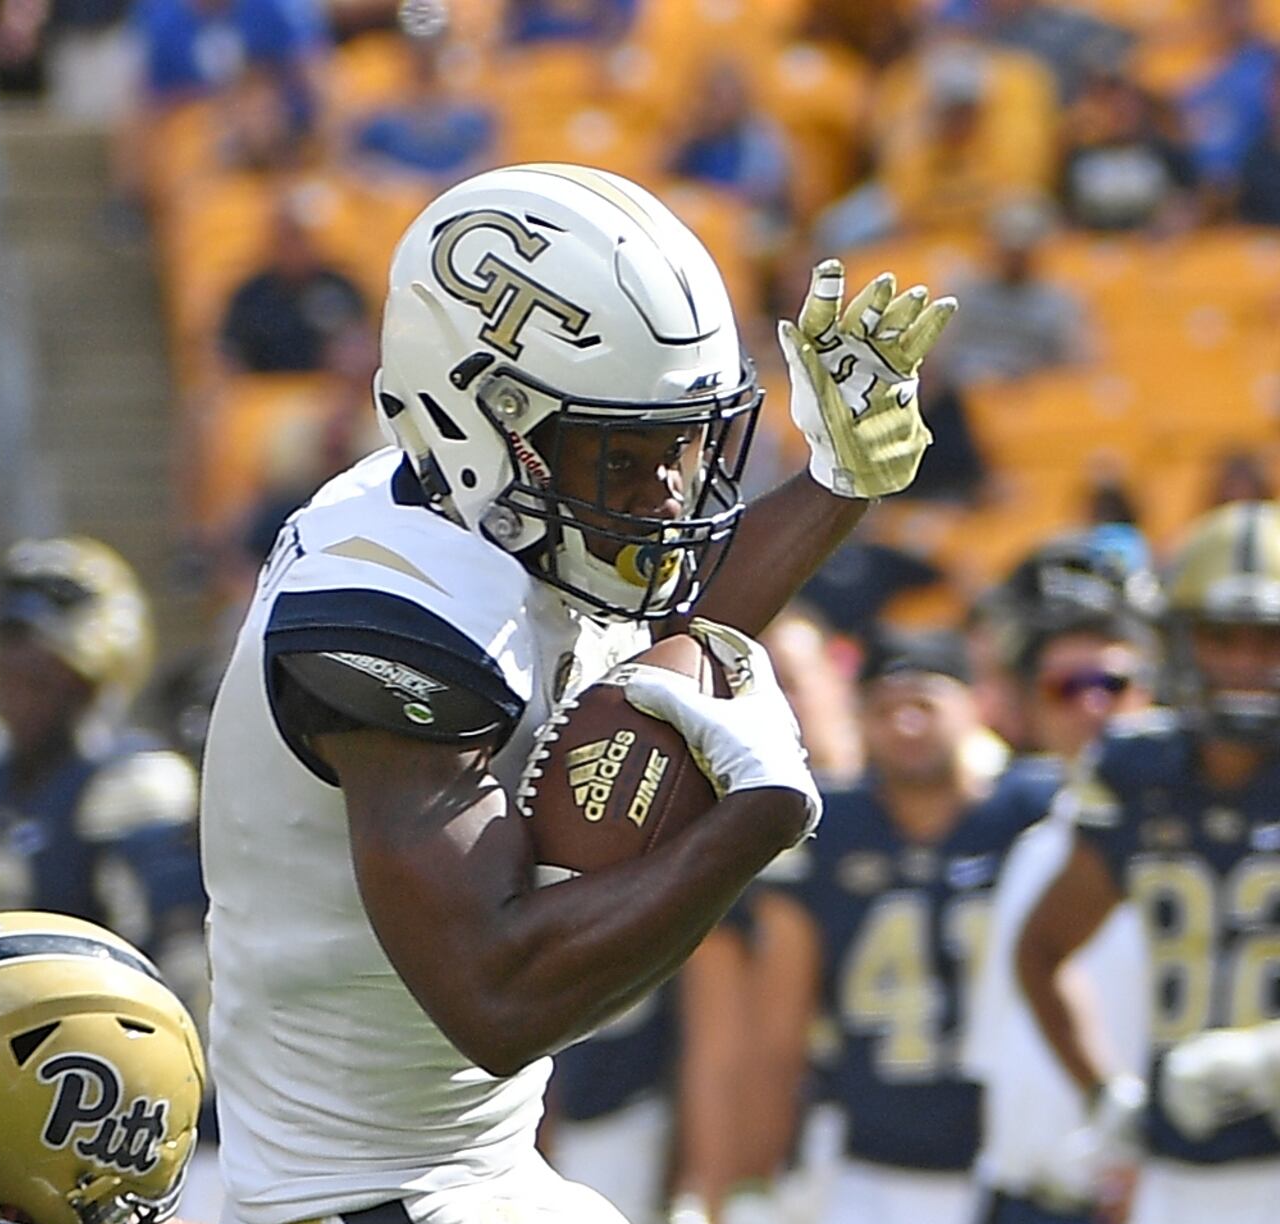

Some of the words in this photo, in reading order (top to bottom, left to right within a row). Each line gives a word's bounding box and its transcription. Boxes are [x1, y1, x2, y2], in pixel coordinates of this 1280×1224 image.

[431, 208, 593, 362] GT
[585, 729, 636, 822] adidas
[626, 747, 670, 828] DIME
[37, 1052, 169, 1176] Pitt
